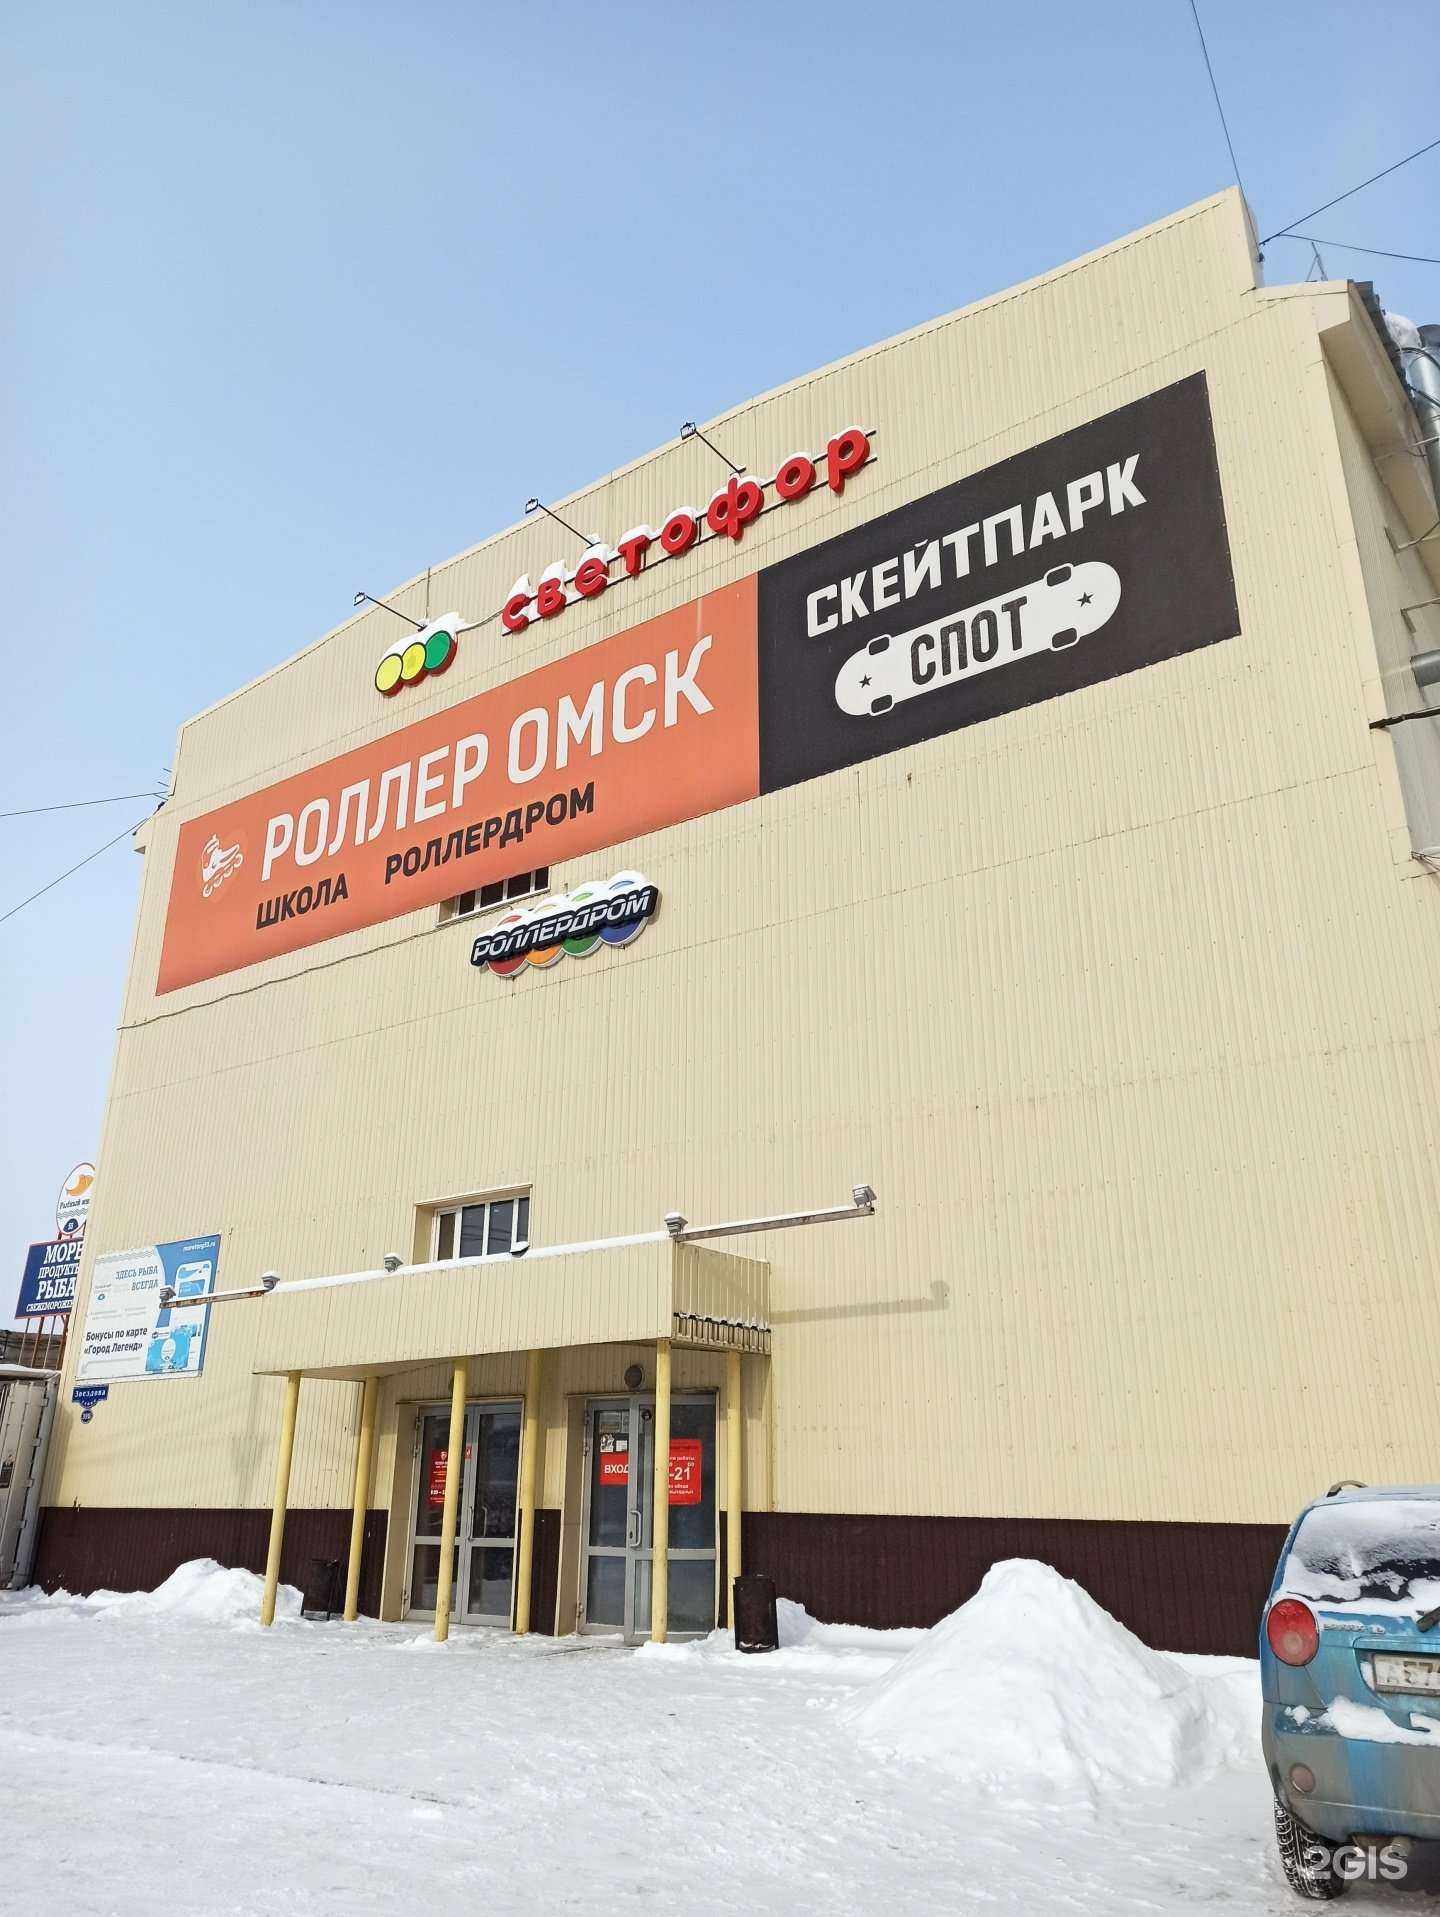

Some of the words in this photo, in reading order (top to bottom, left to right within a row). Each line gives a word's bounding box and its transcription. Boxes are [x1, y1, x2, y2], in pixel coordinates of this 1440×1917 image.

[501, 428, 872, 633] светофор
[806, 453, 1147, 639] СКЕЙТПАРК
[910, 594, 1032, 686] СПОТ
[261, 731, 489, 882] РОЛЛЕР
[506, 634, 715, 784] ОМСК
[384, 781, 595, 885] РОЛЛЕРДРОМ
[255, 873, 348, 930] ШКОЛА
[472, 887, 652, 966] РОЛЛЕРДРОМ
[36, 1277, 76, 1300] РЫБА
[131, 1279, 158, 1291] ВСЕГДА
[84, 1343, 111, 1355] «Город
[111, 1342, 142, 1354] Легенд»
[86, 1329, 114, 1342] Бонусы
[115, 1330, 125, 1338] по
[126, 1327, 148, 1338] карте
